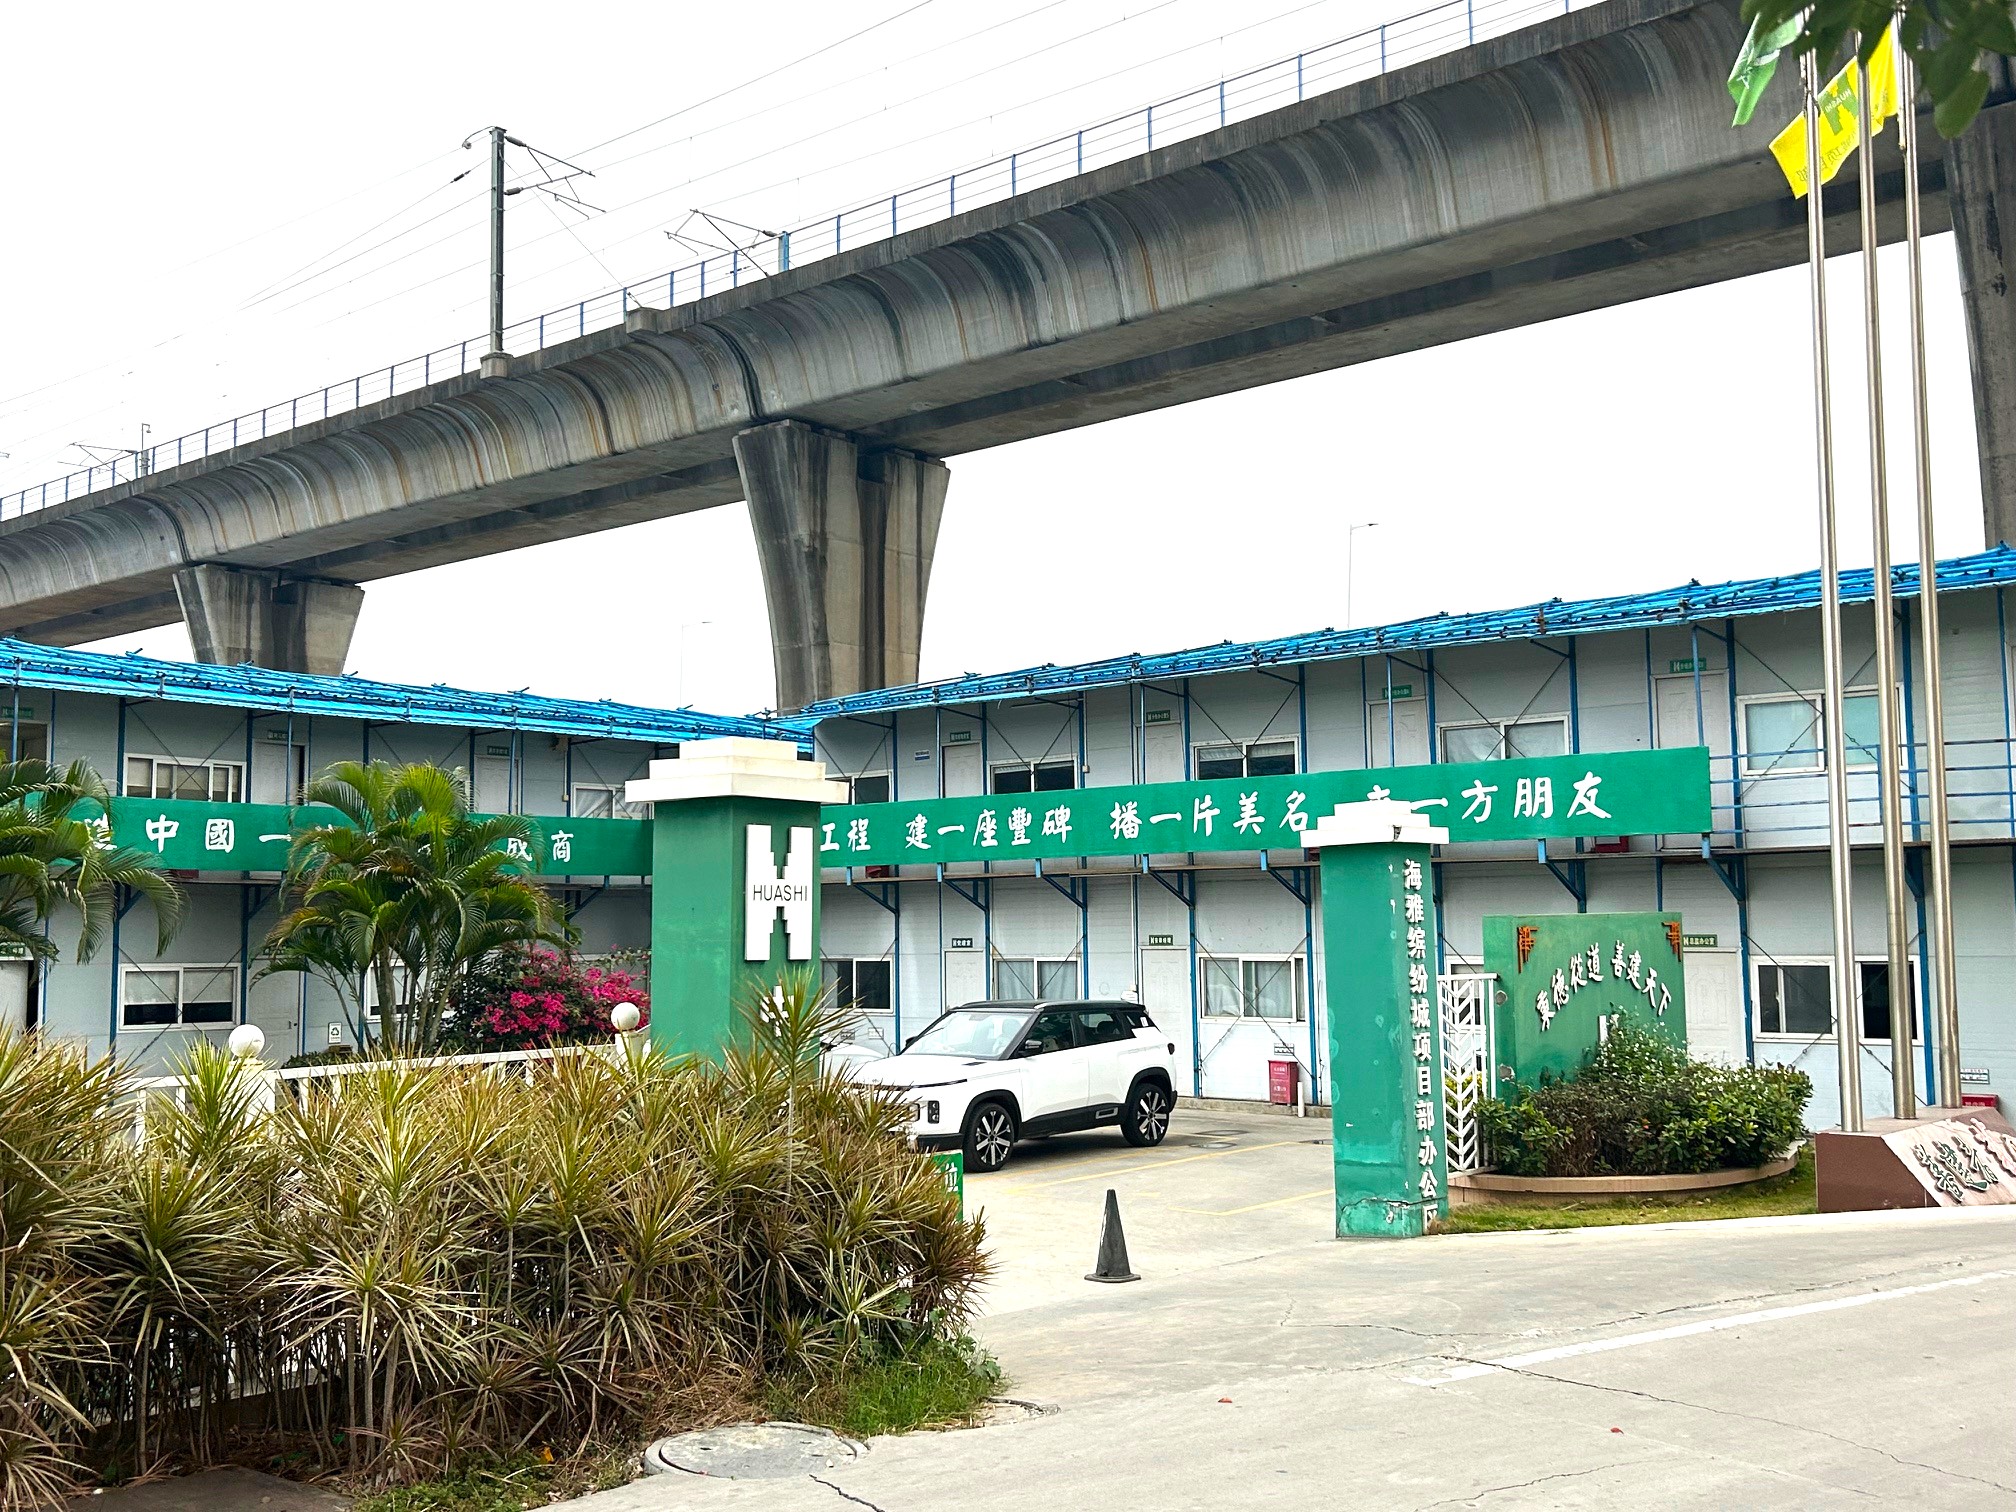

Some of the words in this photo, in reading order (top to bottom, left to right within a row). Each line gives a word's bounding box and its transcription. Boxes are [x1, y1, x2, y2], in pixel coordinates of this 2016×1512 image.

[819, 818, 872, 853] 工程
[904, 804, 1073, 850] 建一座豐碑
[1109, 789, 1309, 840] 播一片美名
[752, 884, 808, 901] HUASHI
[1611, 939, 1673, 1017] 善建天下
[1404, 858, 1439, 1235] 海雅缤纷城项目部办公区
